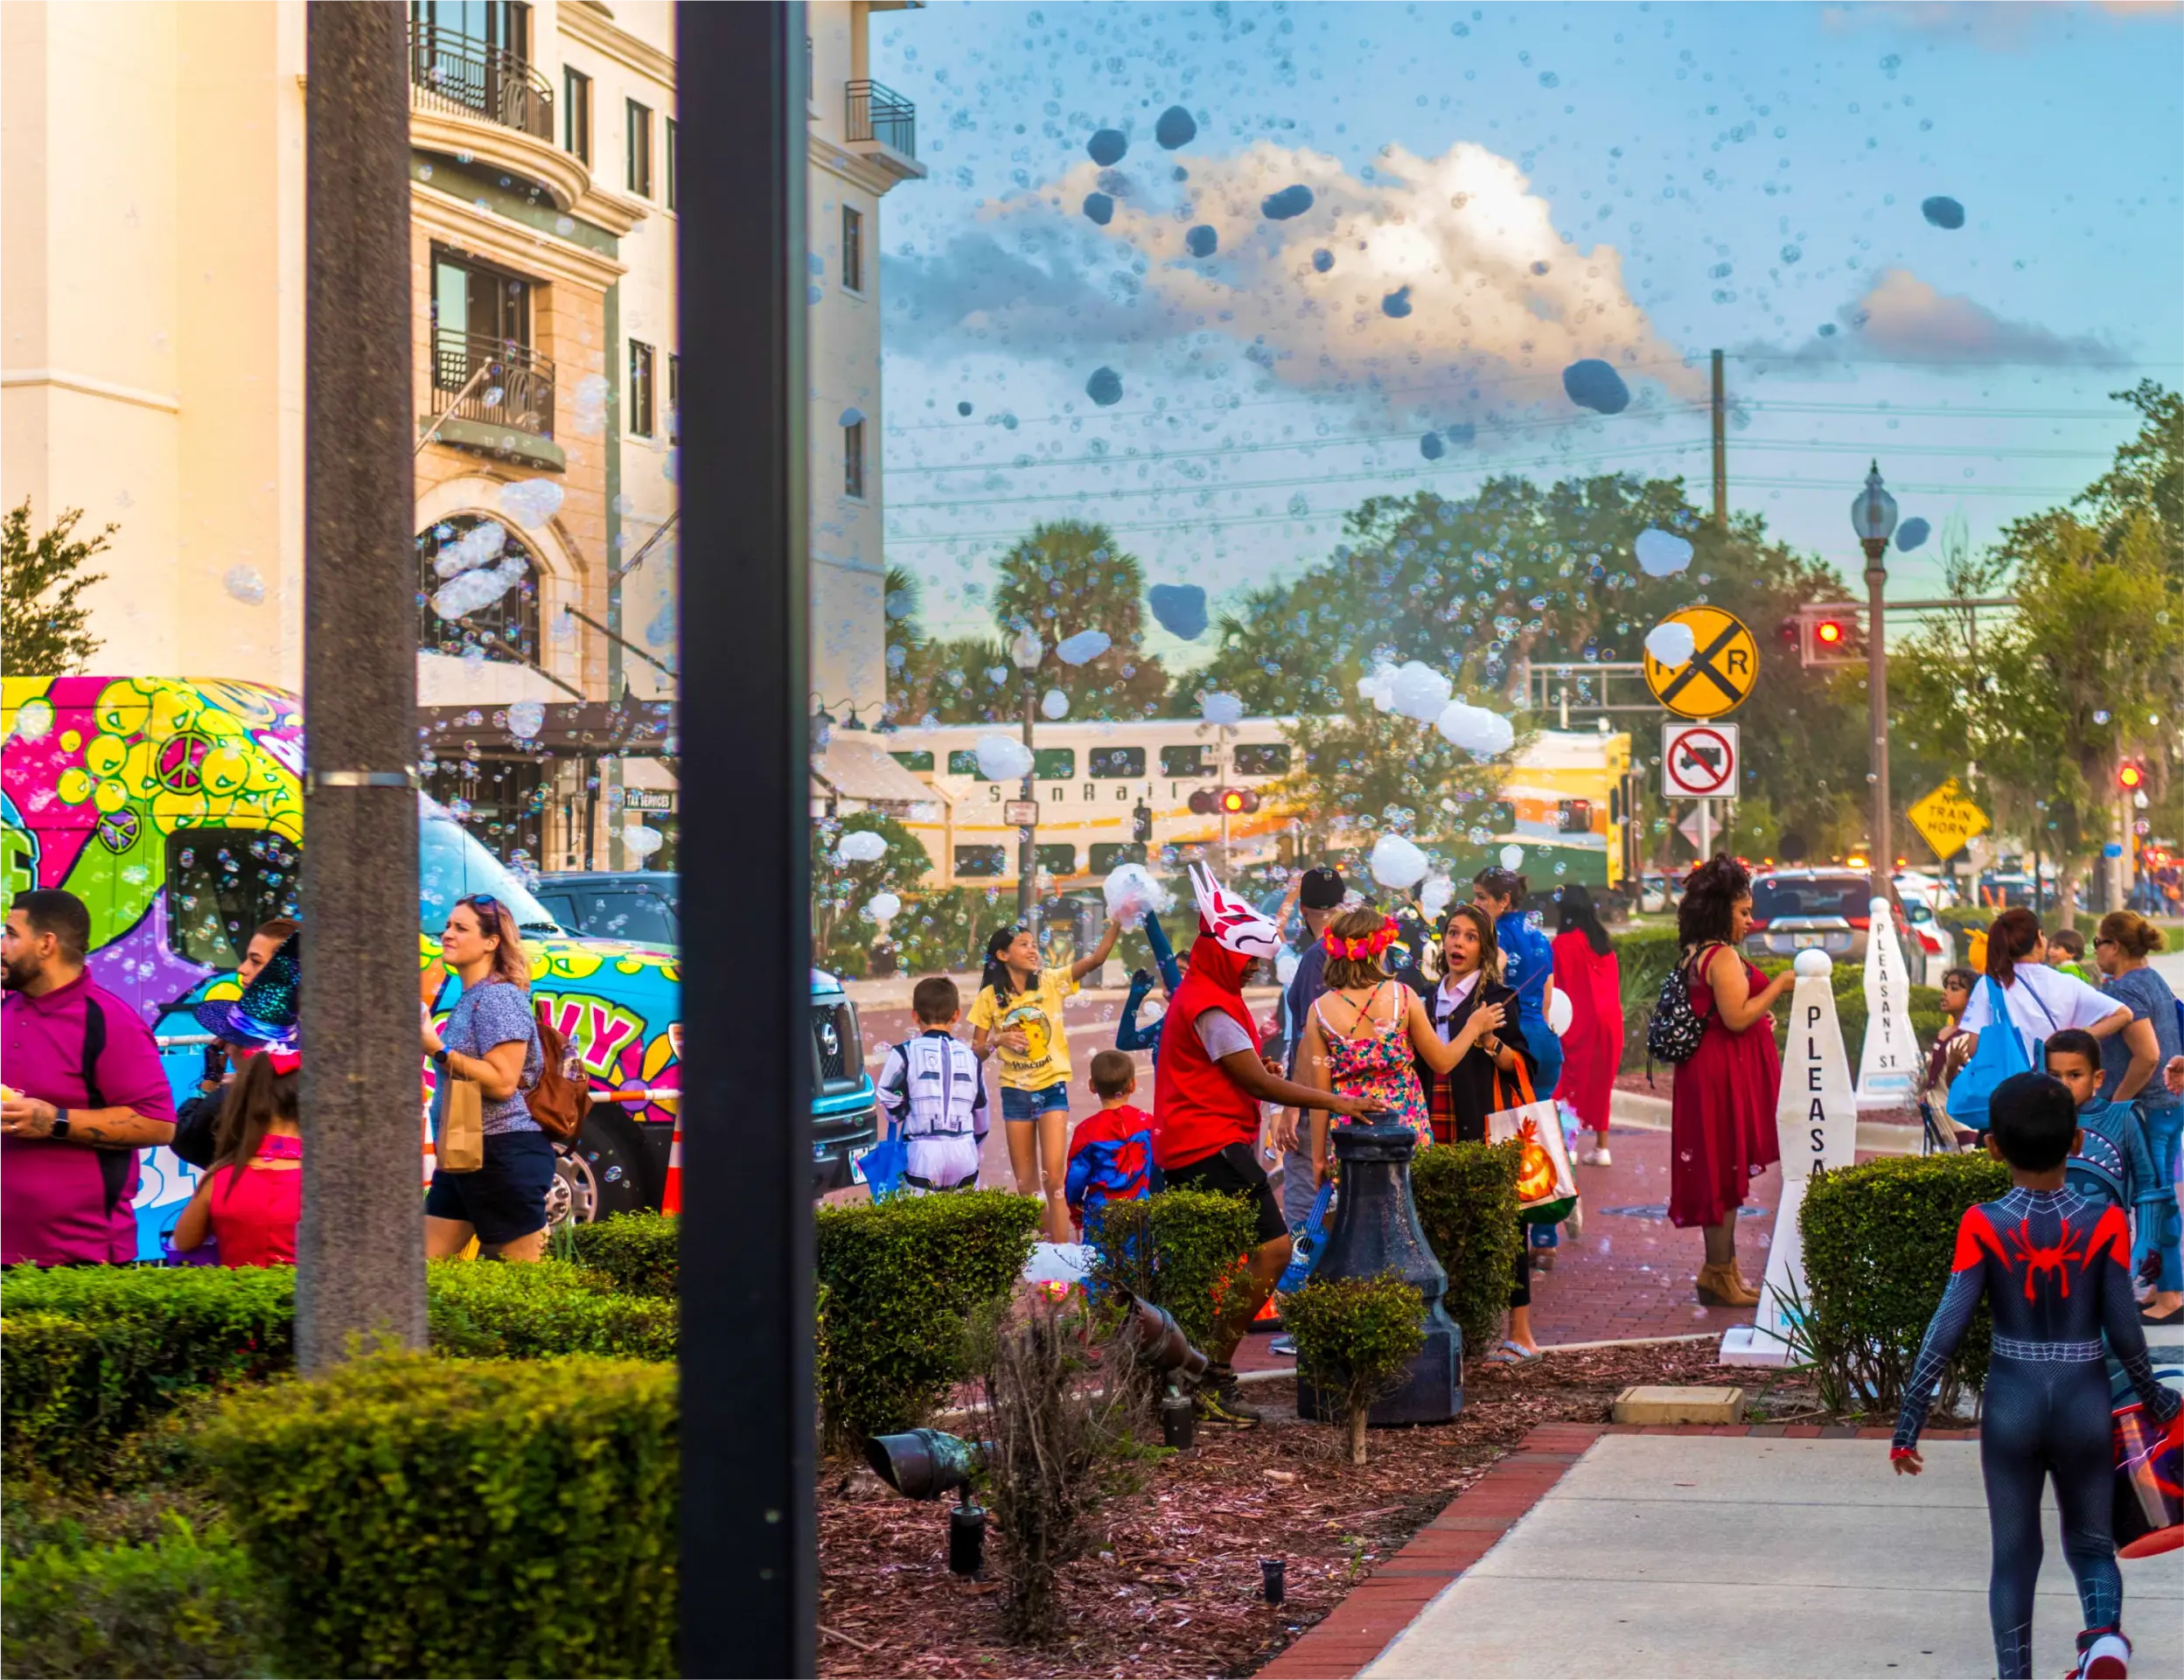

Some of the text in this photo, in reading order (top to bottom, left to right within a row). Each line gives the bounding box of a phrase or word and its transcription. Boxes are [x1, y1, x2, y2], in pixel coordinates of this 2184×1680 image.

[1727, 650, 1748, 675] R
[641, 793, 670, 808] SERVICES
[989, 781, 1177, 803] SnRail
[1929, 805, 1971, 822] TRAIN
[1928, 821, 1968, 836] HORN
[1875, 923, 1891, 1044] PLEASANT
